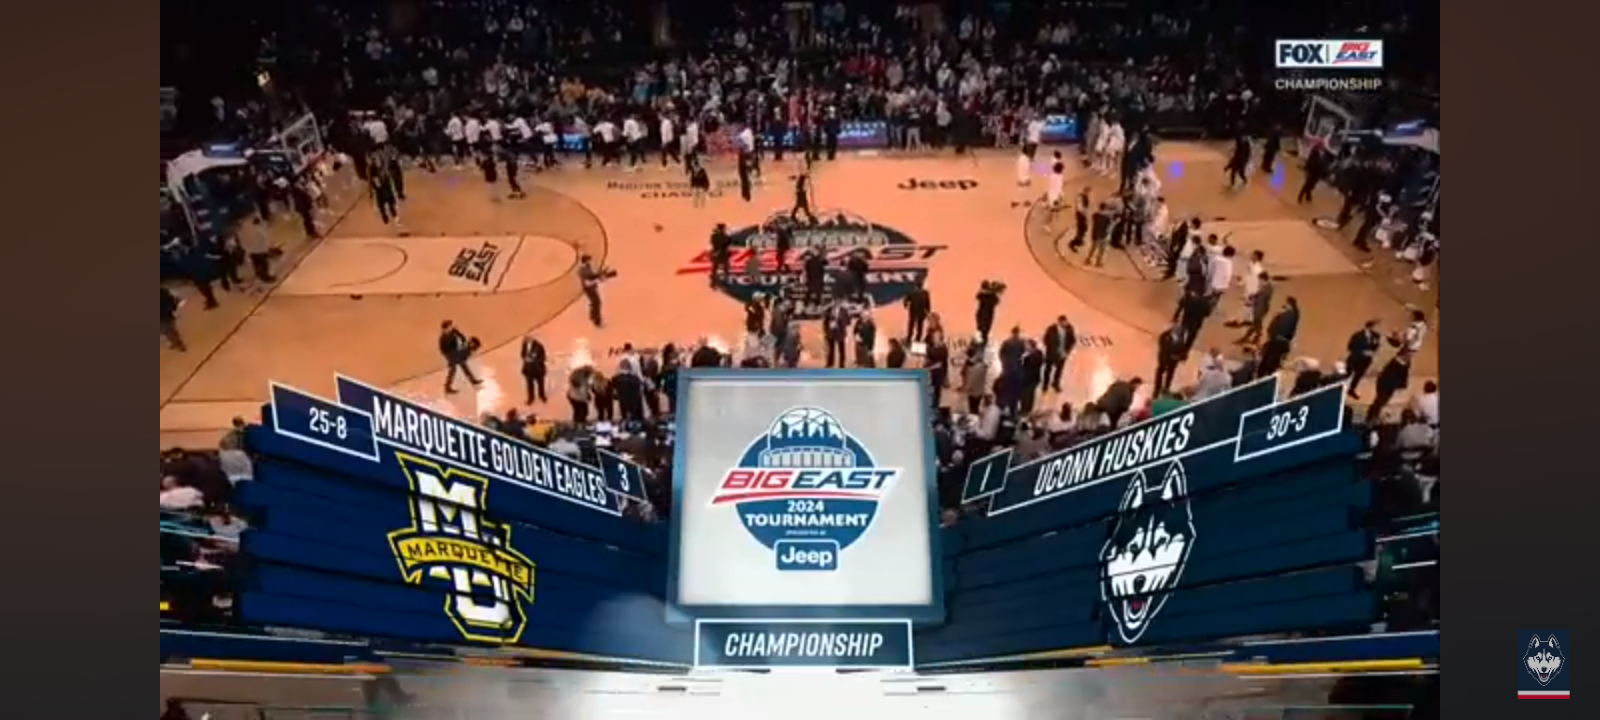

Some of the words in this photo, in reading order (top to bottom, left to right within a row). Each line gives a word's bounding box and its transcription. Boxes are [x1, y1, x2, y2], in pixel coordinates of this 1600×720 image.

[897, 178, 979, 191] Jeep
[448, 247, 477, 278] BIG
[465, 241, 498, 282] EAST
